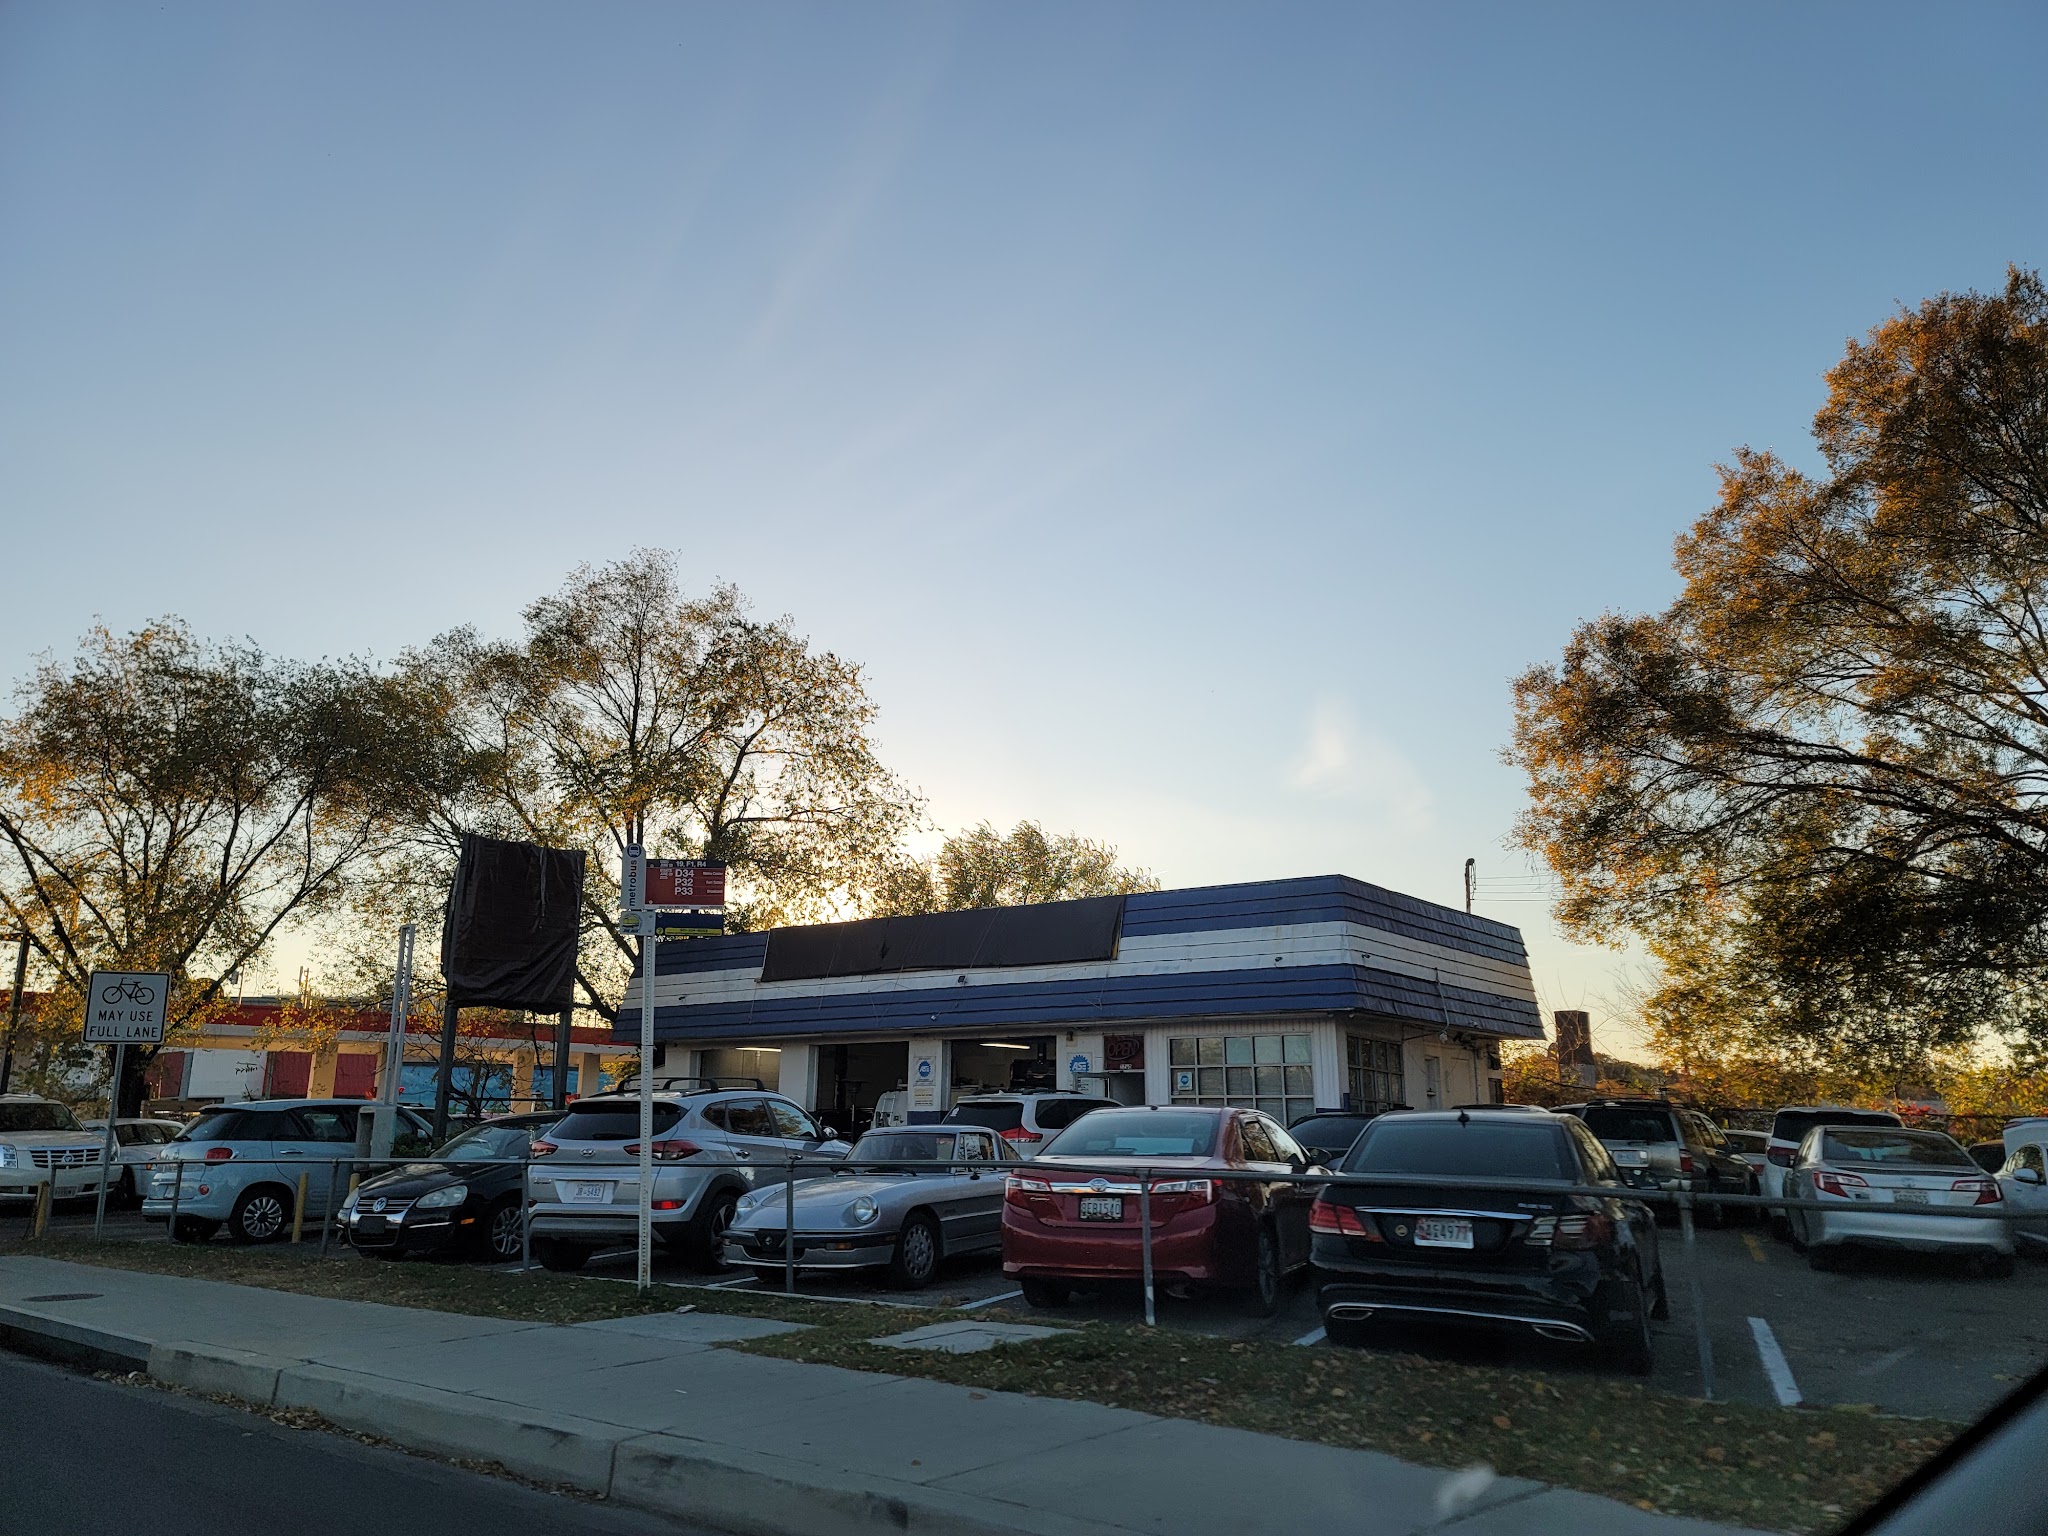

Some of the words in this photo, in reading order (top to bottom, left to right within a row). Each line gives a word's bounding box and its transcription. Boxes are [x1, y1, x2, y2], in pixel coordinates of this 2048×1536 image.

[674, 869, 695, 878] D34
[628, 860, 638, 907] metrobus
[674, 878, 694, 887] P32
[674, 887, 694, 896] P33
[98, 1010, 124, 1021] MAY
[129, 1011, 153, 1022] USE
[89, 1026, 121, 1037] FULL
[126, 1027, 158, 1038] LANE
[1108, 1041, 1137, 1057] OPEN
[1071, 1061, 1087, 1071] ASE
